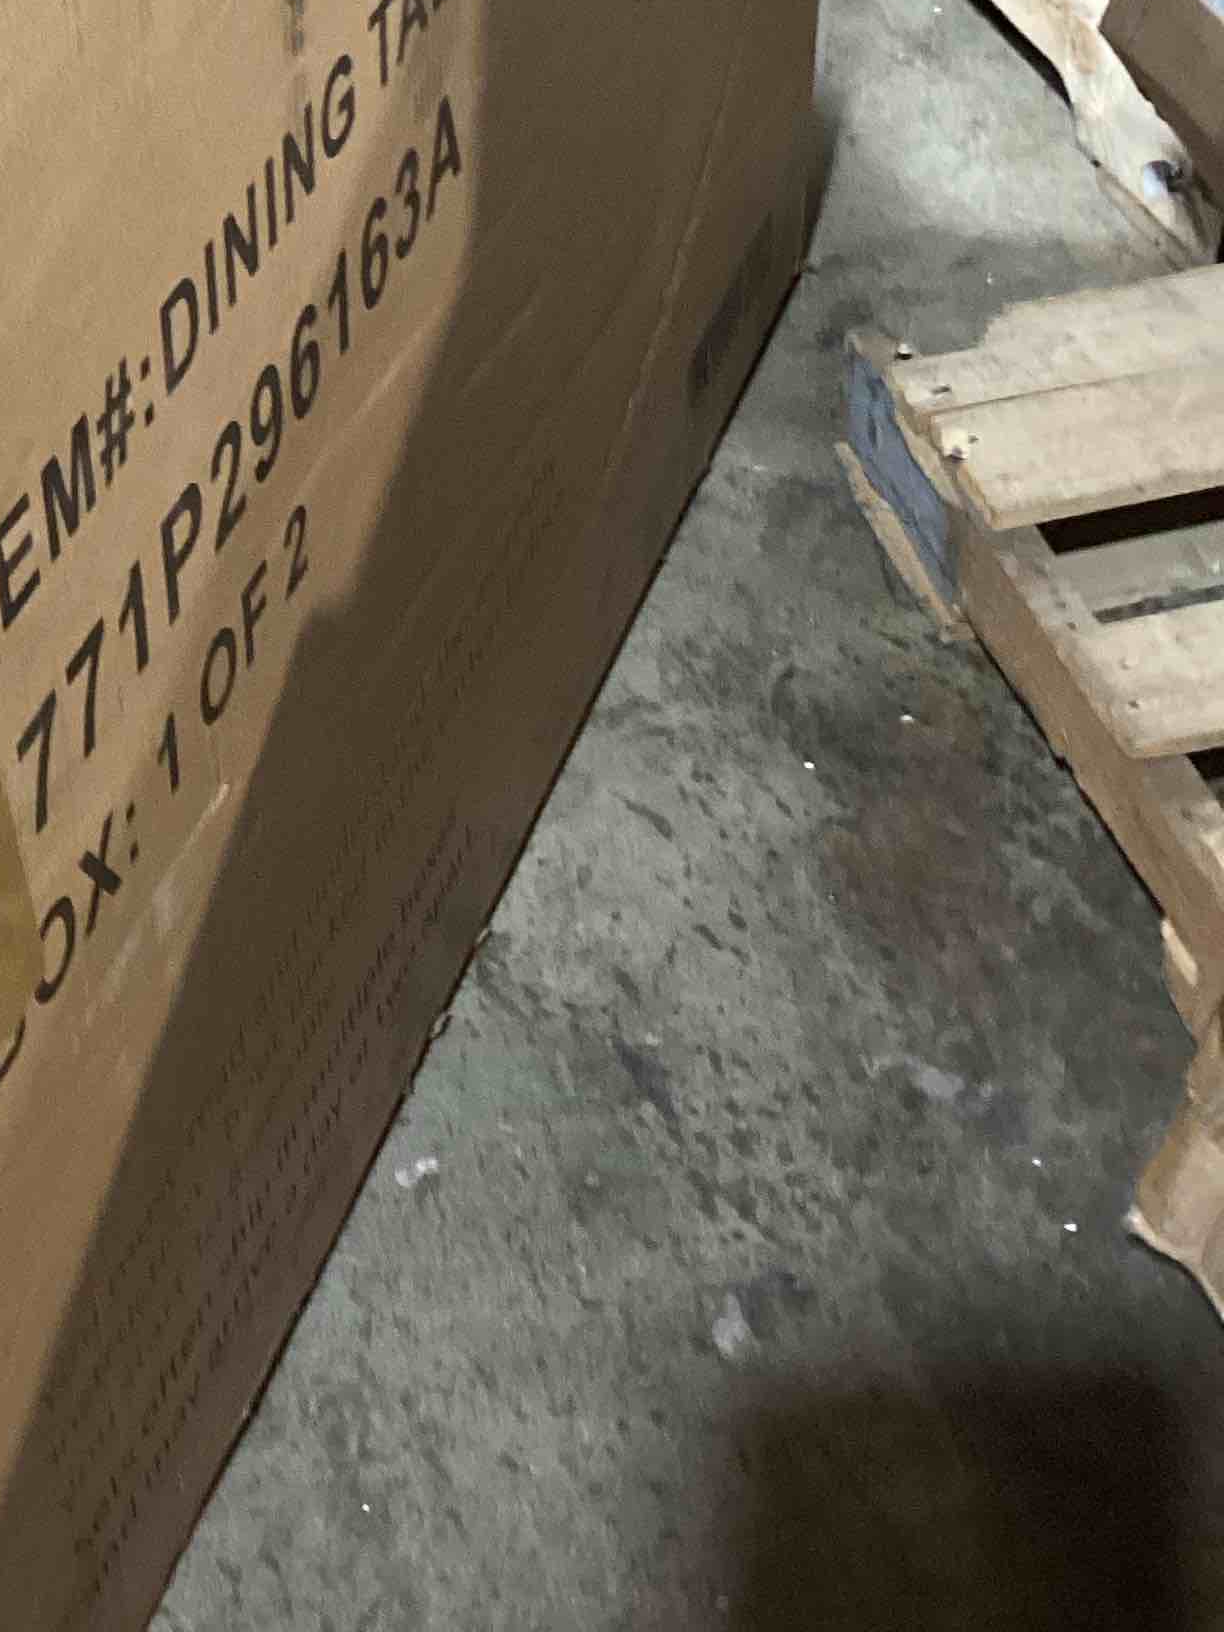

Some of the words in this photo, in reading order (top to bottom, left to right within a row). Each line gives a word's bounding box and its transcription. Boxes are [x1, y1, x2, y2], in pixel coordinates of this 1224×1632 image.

[16, 95, 462, 833] 771P296163A
[158, 712, 180, 794] 1
[200, 559, 268, 726] OF
[284, 504, 309, 601] 2
